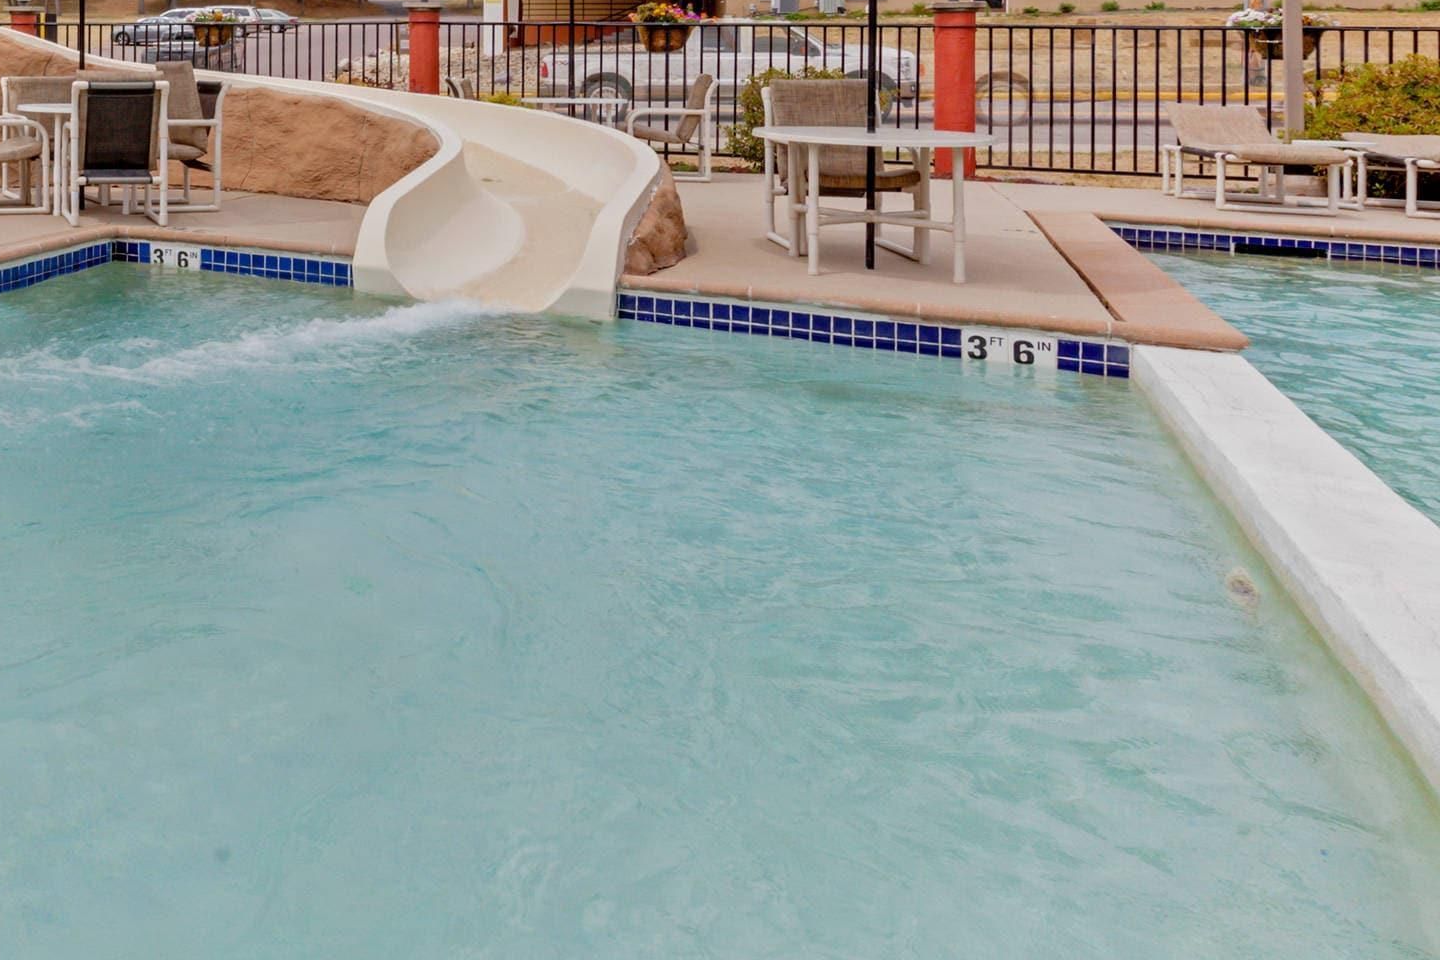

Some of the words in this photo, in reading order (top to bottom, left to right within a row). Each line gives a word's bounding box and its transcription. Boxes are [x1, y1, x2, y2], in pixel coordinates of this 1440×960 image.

[153, 248, 164, 264] 3
[177, 251, 189, 268] 6
[967, 335, 988, 360] 3
[989, 337, 1004, 346] FT
[1013, 340, 1035, 365] 6
[1037, 342, 1052, 352] IN
